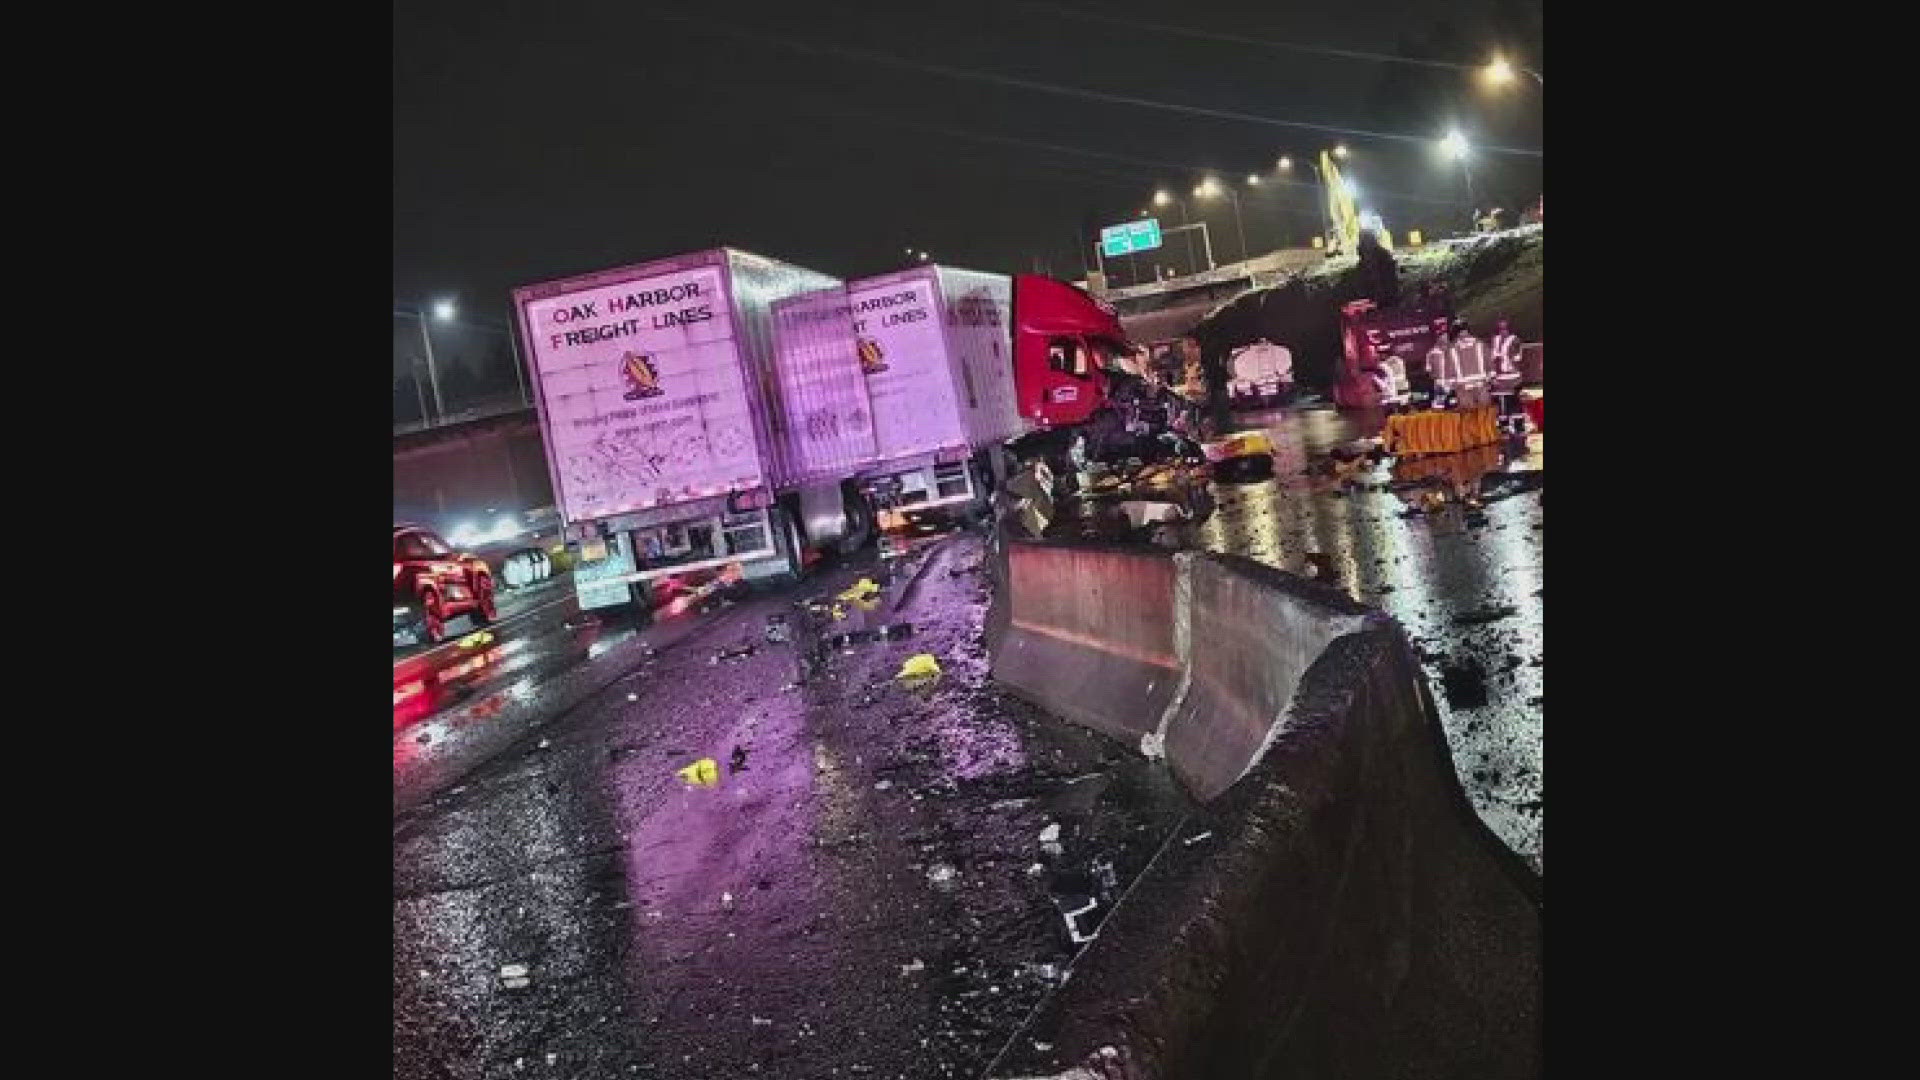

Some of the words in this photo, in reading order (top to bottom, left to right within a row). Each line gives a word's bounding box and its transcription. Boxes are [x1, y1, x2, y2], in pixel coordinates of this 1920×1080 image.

[553, 301, 598, 323] OAK
[608, 283, 700, 313] HARBOR
[882, 307, 928, 328] LINES
[550, 318, 639, 350] FREIGHT
[652, 304, 713, 331] LINES
